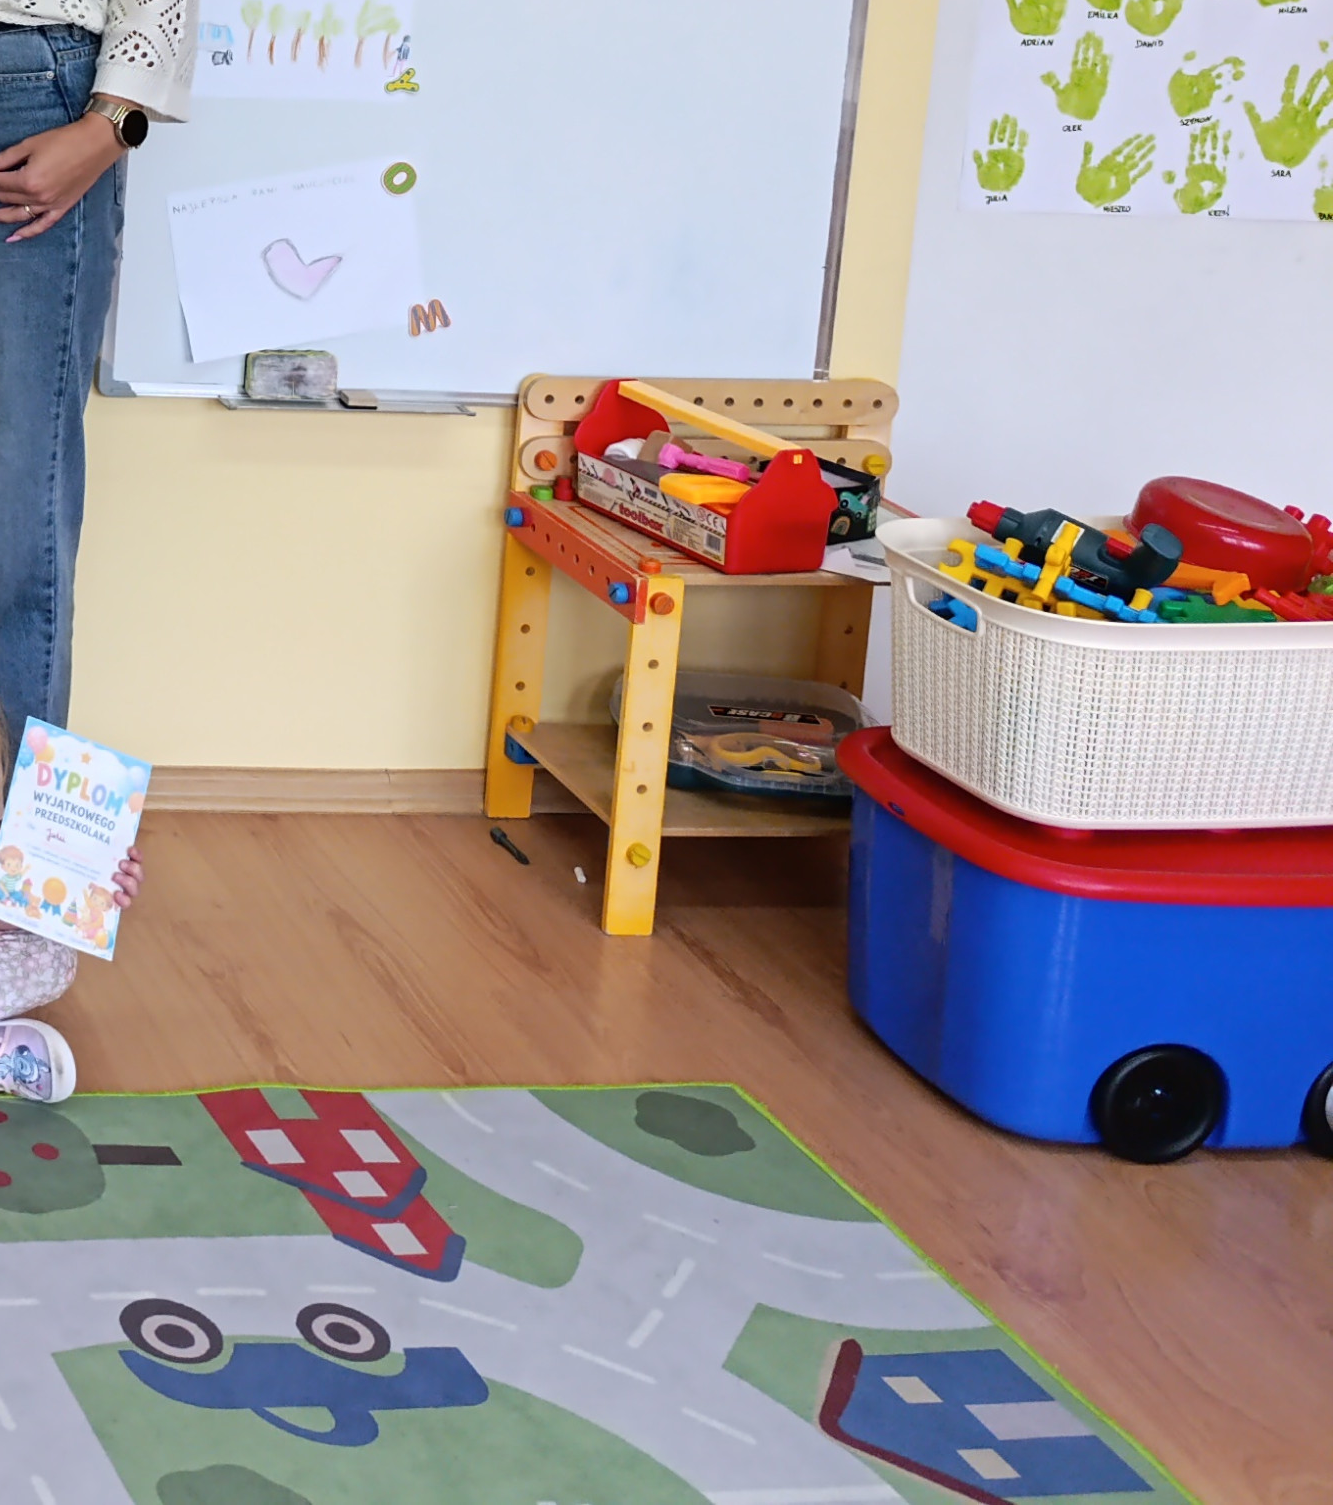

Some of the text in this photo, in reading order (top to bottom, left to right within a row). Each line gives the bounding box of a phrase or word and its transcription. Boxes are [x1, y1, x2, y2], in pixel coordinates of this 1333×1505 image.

[1271, 168, 1292, 178] SARA
[36, 761, 125, 817] DYPLOM
[33, 789, 116, 832] WYJĄTKOWEGO
[34, 807, 112, 846] PRZEDSZKOLAKA
